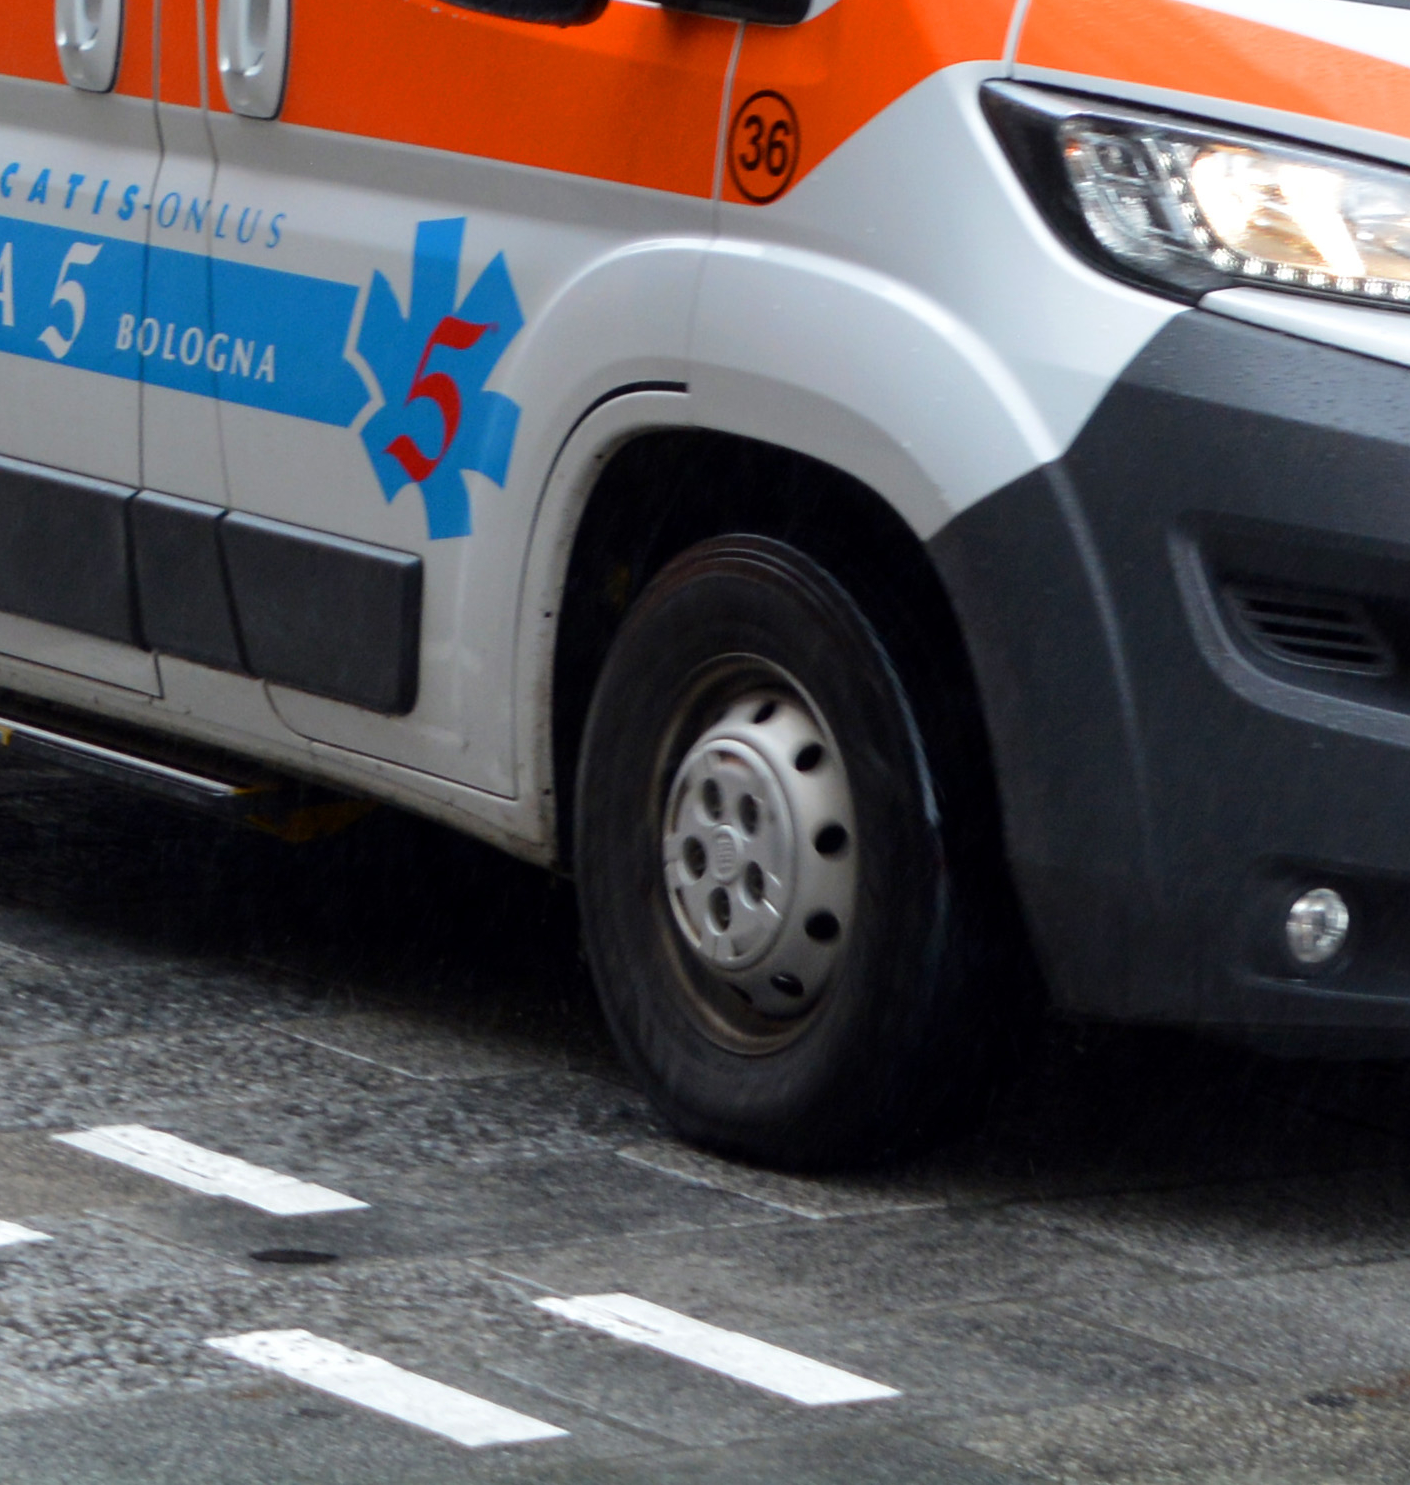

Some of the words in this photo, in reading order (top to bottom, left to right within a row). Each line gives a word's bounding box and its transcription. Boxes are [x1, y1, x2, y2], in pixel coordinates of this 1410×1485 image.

[739, 115, 791, 177] 36
[37, 242, 103, 360] 5
[115, 313, 276, 384] BOLOGNA
[383, 315, 500, 483] 5
